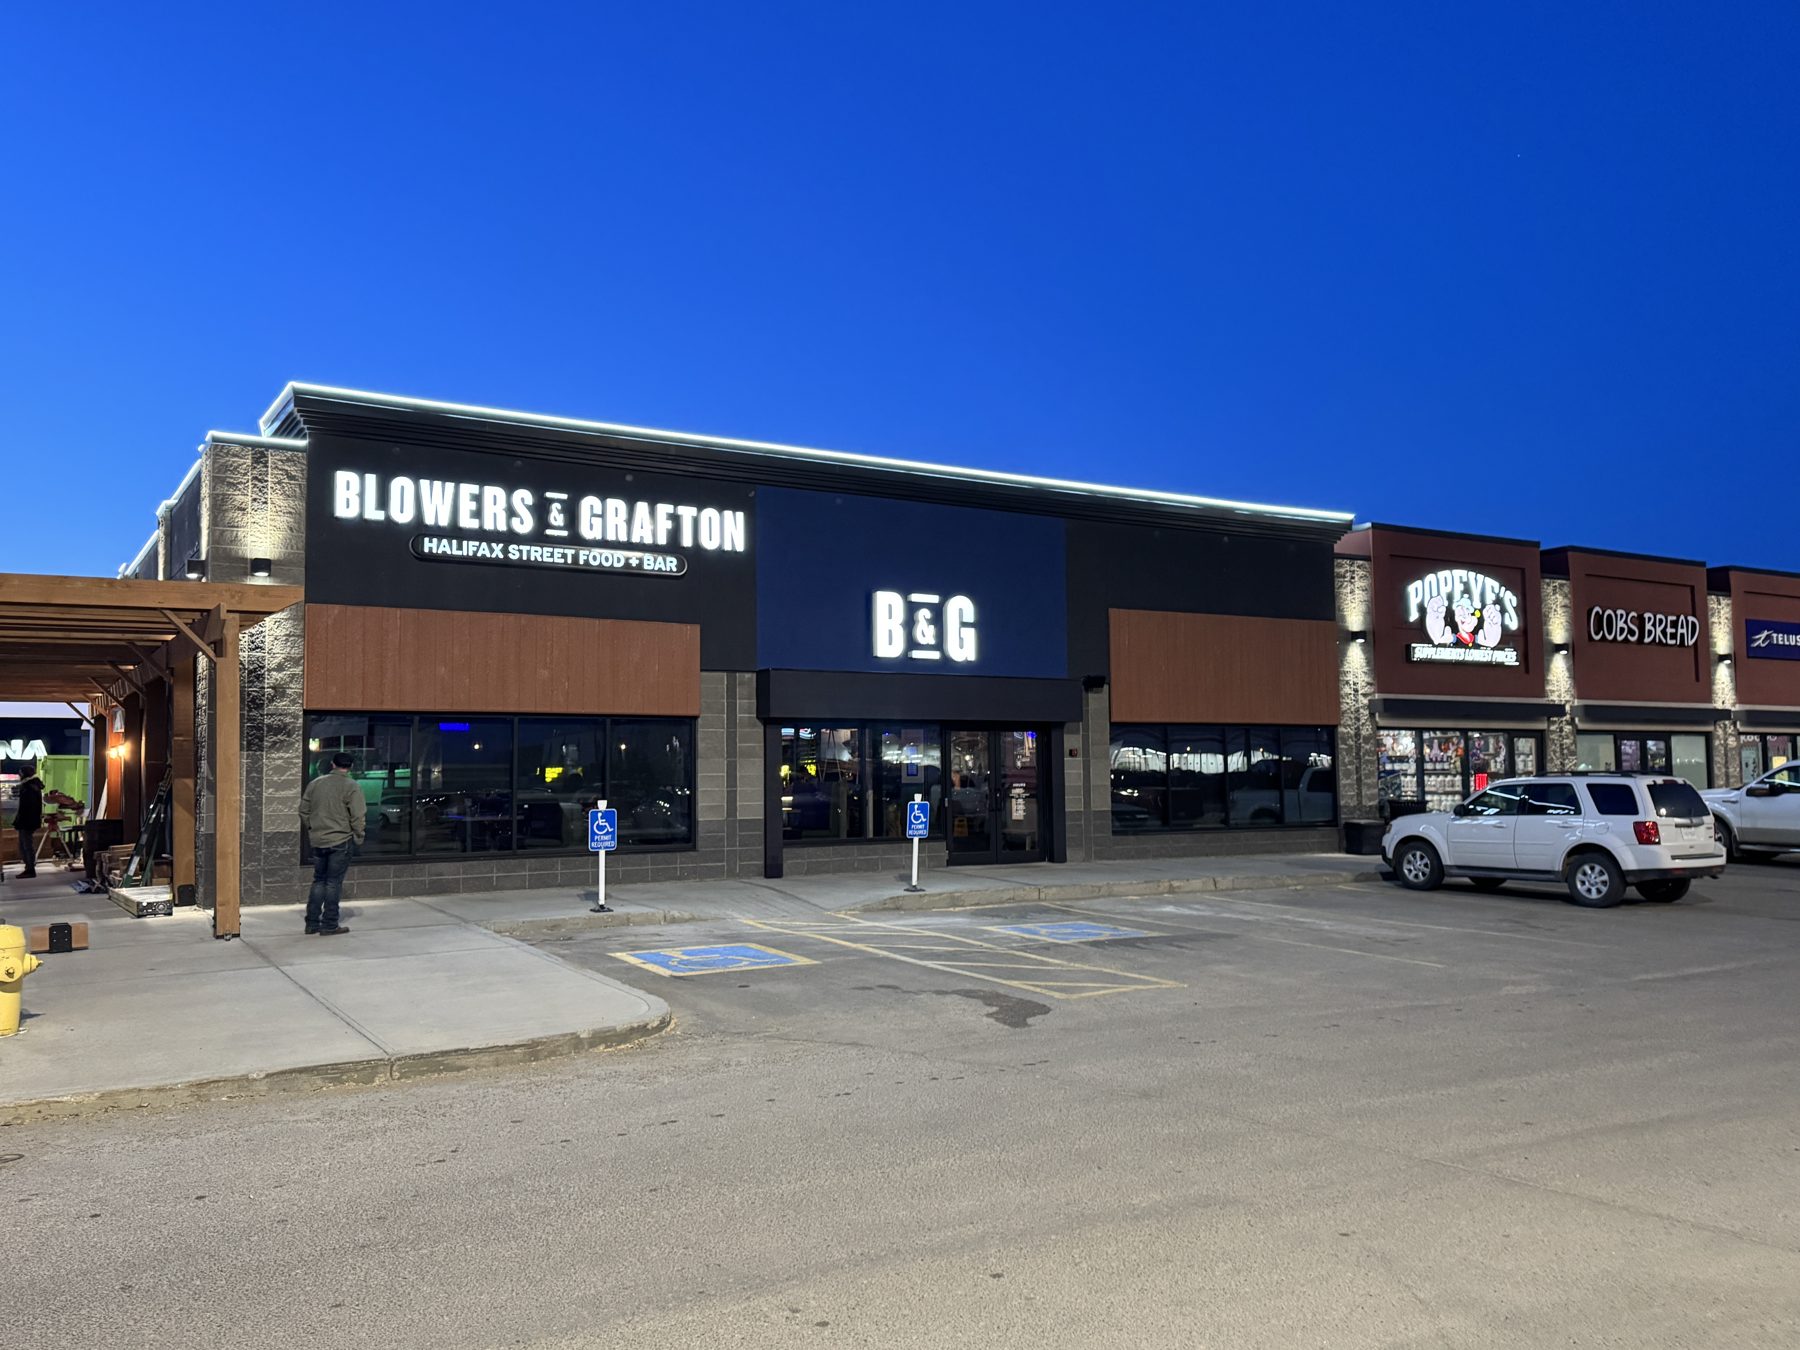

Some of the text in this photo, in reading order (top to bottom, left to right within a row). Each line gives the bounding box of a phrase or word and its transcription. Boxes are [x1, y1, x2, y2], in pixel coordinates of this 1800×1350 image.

[333, 470, 536, 536] BLOWERS
[578, 495, 746, 553] GRAFTON
[422, 537, 504, 559] HALIFAX
[507, 544, 575, 565] STREET
[578, 549, 625, 568] FOOD
[643, 554, 677, 572] BAR
[1407, 569, 1519, 631] POPEYE'S
[1590, 606, 1700, 647] COBS BREAD
[591, 840, 615, 848] REQUIRED
